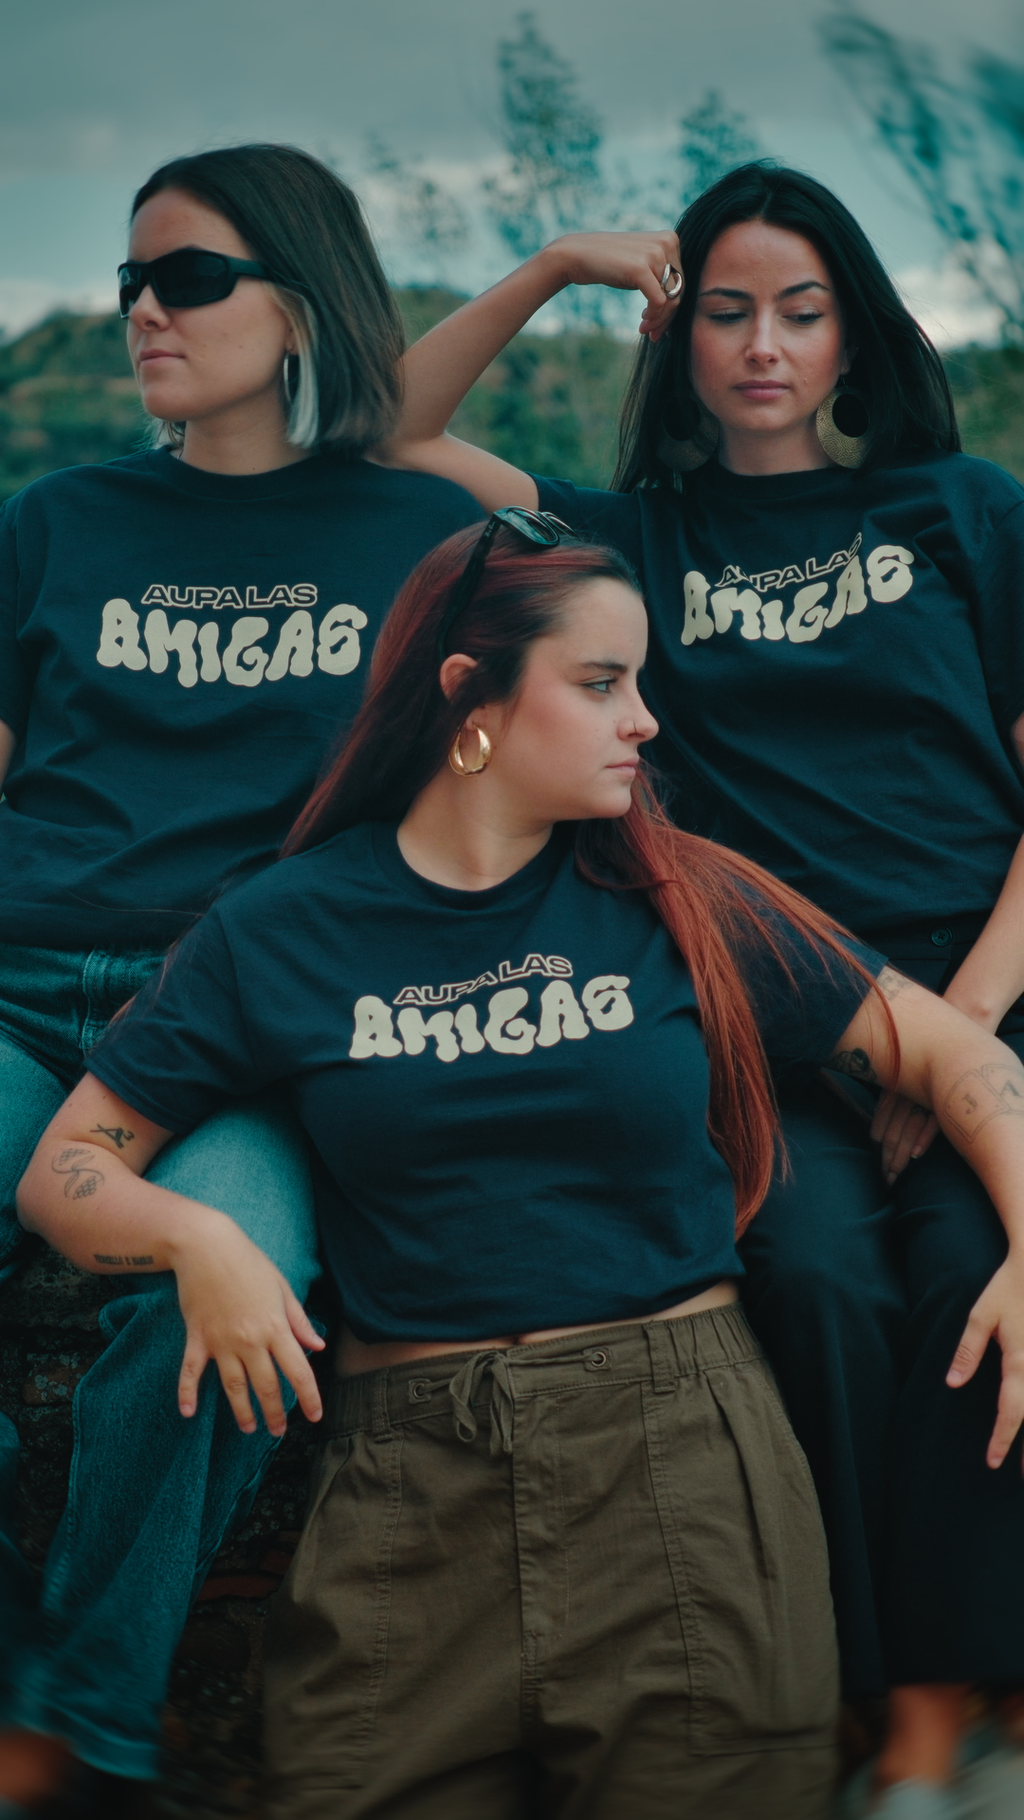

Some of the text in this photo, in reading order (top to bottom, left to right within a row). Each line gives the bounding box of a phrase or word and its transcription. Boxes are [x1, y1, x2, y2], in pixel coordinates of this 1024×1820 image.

[141, 583, 318, 609] AUPA LAS
[681, 544, 915, 646] AMIGAS
[96, 598, 368, 688] AMIGAS
[349, 975, 635, 1063] AMIGAS
[393, 954, 574, 1005] AUPA LAS
